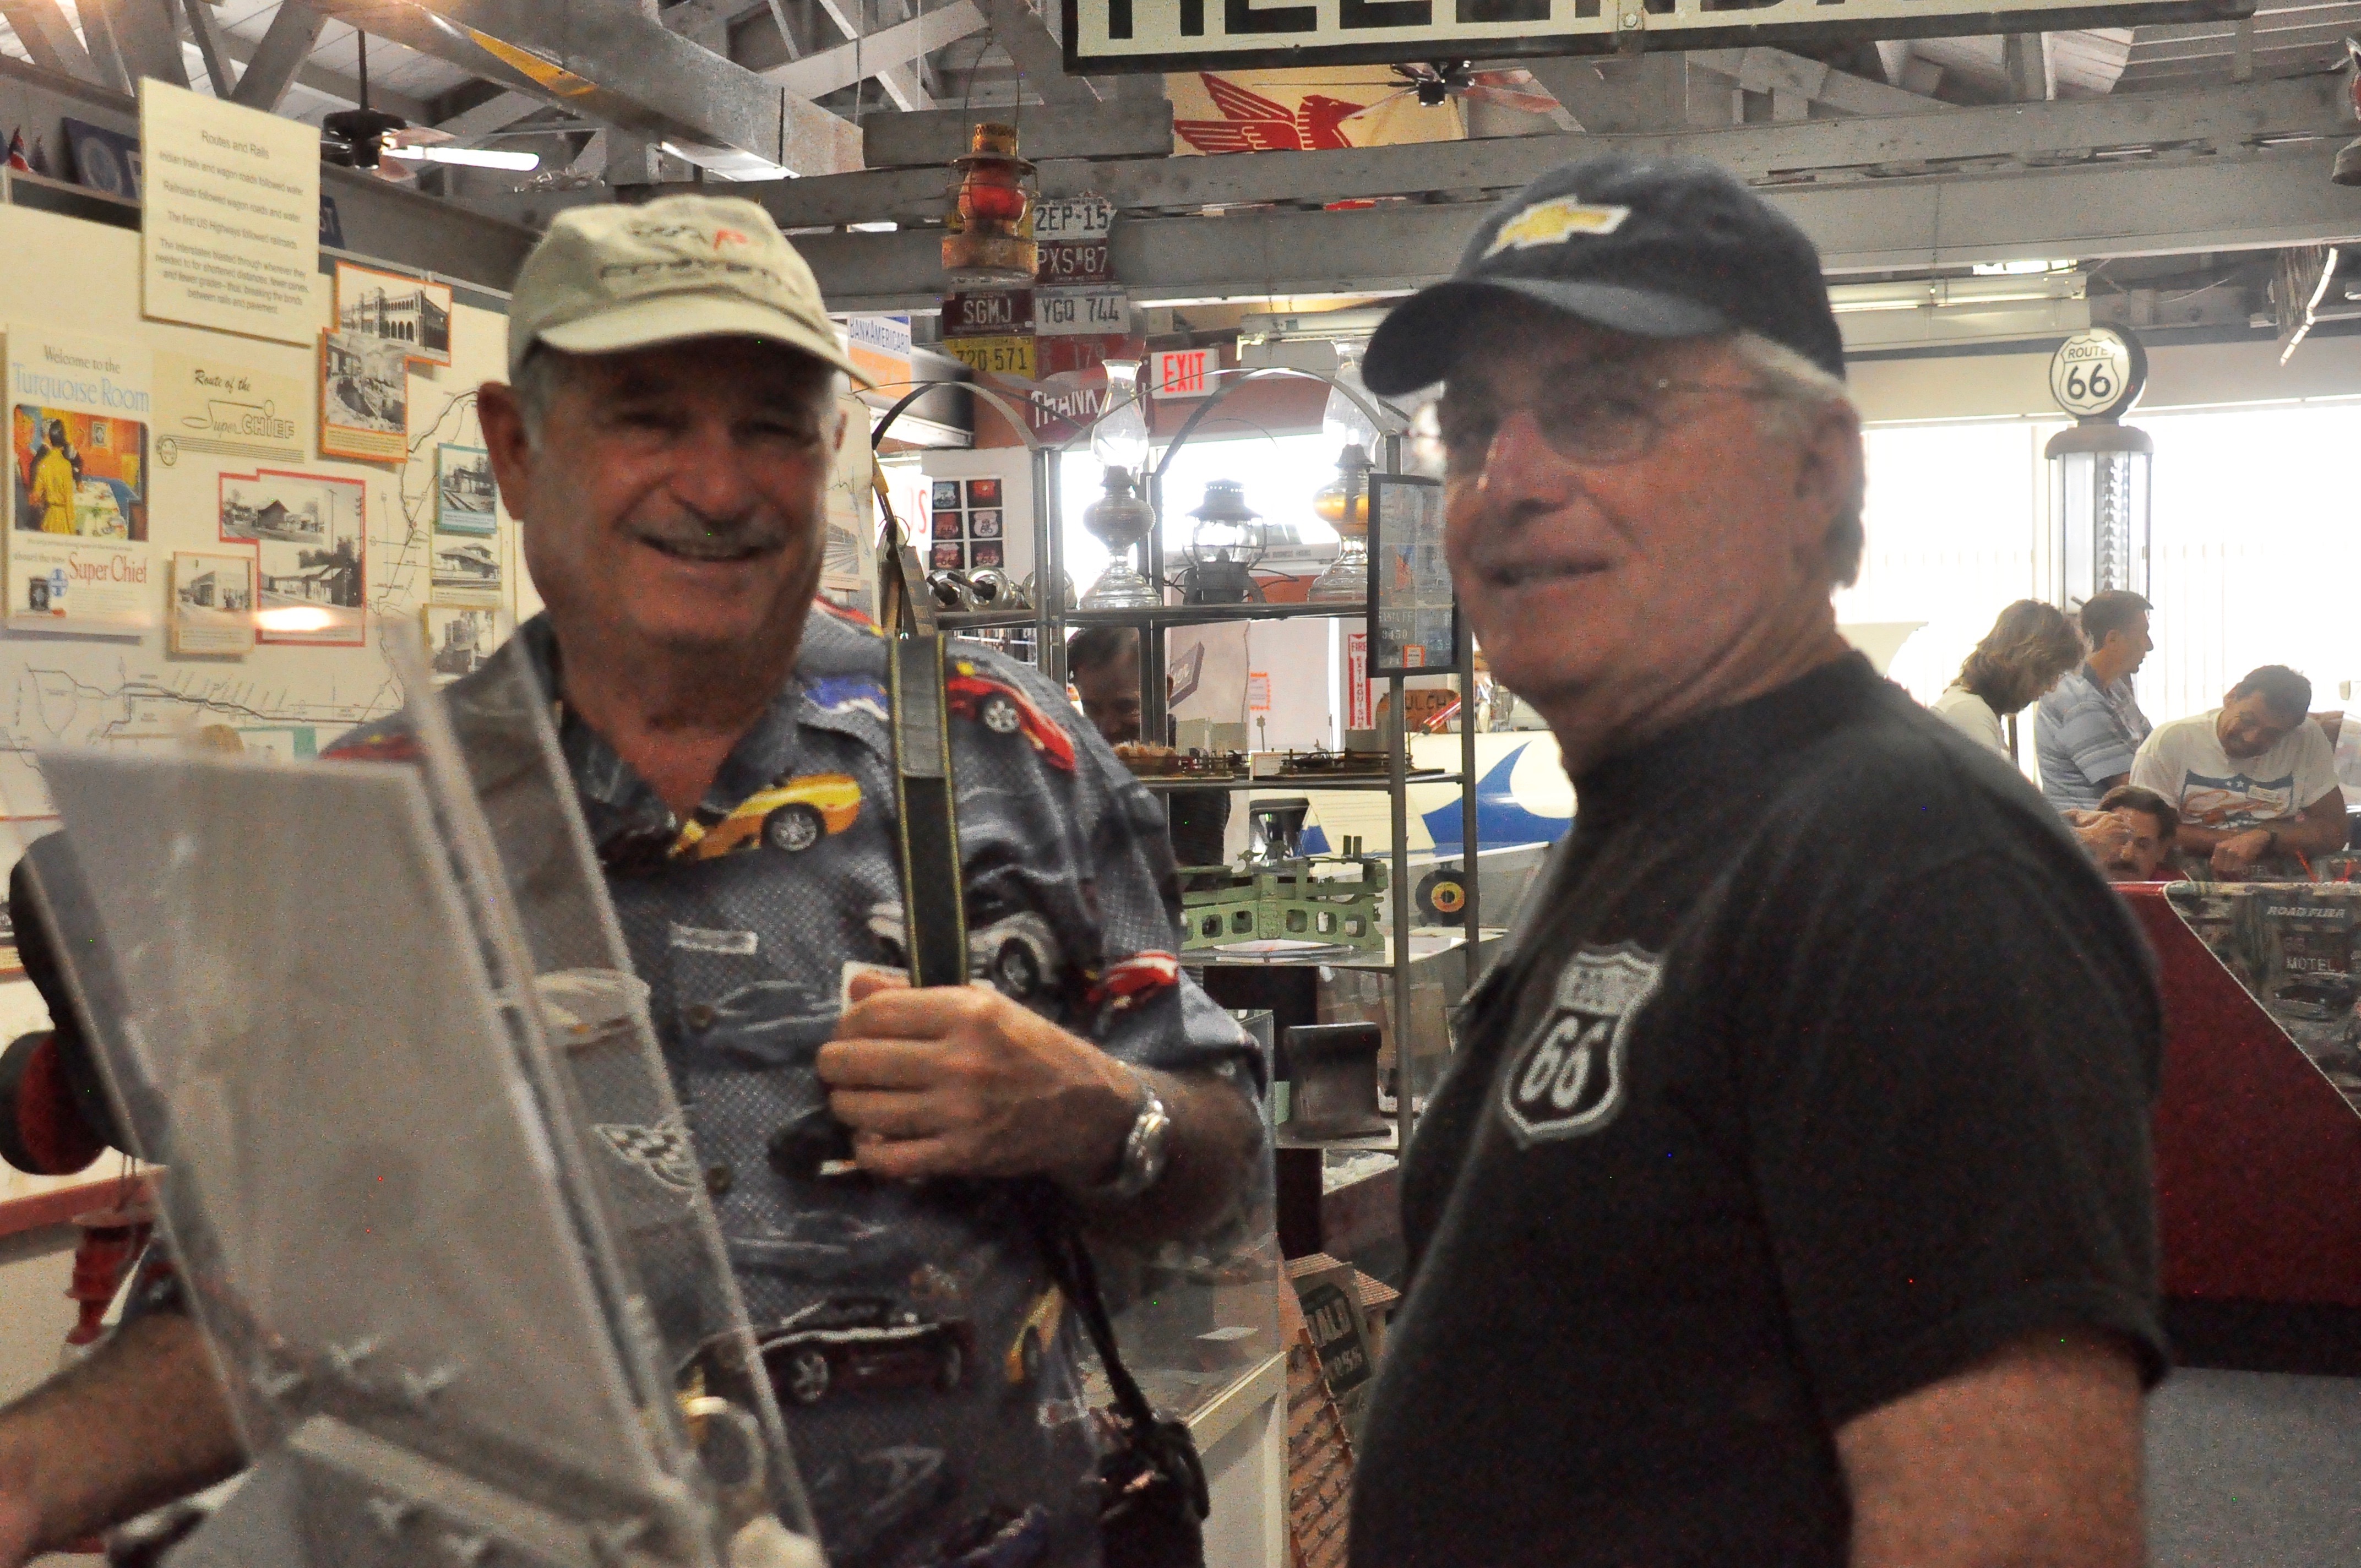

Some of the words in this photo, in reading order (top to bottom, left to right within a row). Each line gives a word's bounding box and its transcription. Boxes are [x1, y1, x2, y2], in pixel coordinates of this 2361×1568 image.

[202, 130, 230, 149] Routes
[233, 141, 248, 153] and
[250, 144, 270, 160] Rails
[202, 163, 215, 173] and
[168, 211, 182, 223] The
[182, 215, 195, 226] first
[197, 219, 208, 230] US
[270, 208, 282, 219] and
[160, 238, 174, 249] The
[44, 345, 90, 369] Welcome
[93, 360, 104, 371] to
[105, 357, 121, 374] the
[2068, 345, 2109, 358] ROUTE
[195, 369, 221, 387] Route
[225, 377, 235, 394] of
[238, 377, 251, 391] the
[1162, 352, 1207, 393] EXIT
[2067, 363, 2111, 400] 66
[13, 362, 97, 405] Turquoise
[101, 376, 150, 412] Room
[69, 551, 108, 586] Super
[111, 553, 148, 584] Chief
[1351, 641, 1367, 652] FIRE
[2286, 957, 2335, 972] MOTEL
[1519, 1015, 1611, 1109] 66
